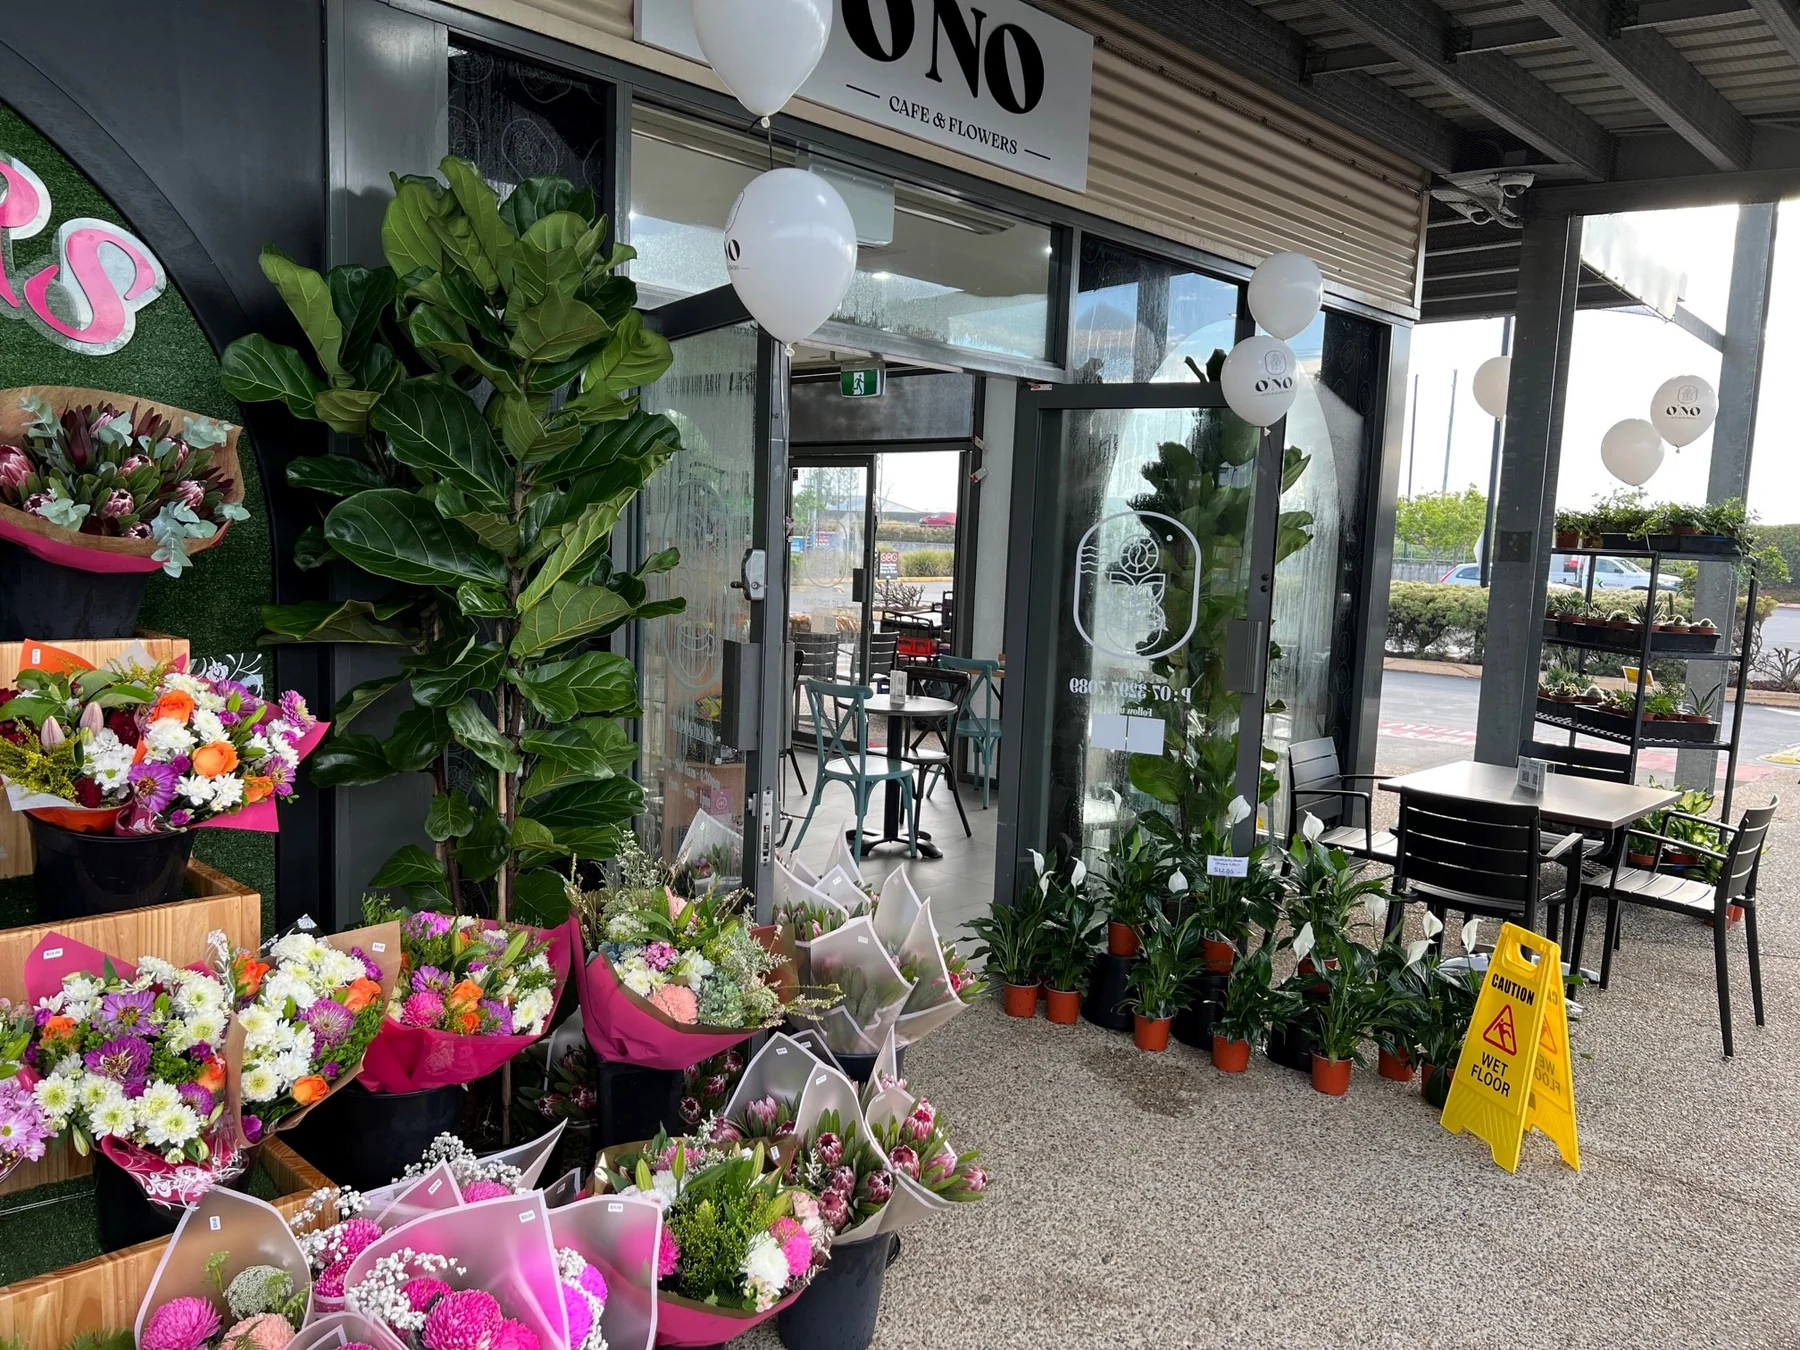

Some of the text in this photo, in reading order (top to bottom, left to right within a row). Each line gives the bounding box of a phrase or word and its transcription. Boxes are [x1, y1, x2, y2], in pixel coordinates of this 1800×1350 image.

[889, 95, 1018, 155] CAFE & FLOWERS
[1491, 973, 1535, 1006] CAUTION
[1470, 1063, 1511, 1098] FLOOR
[1481, 1051, 1509, 1077] WET
